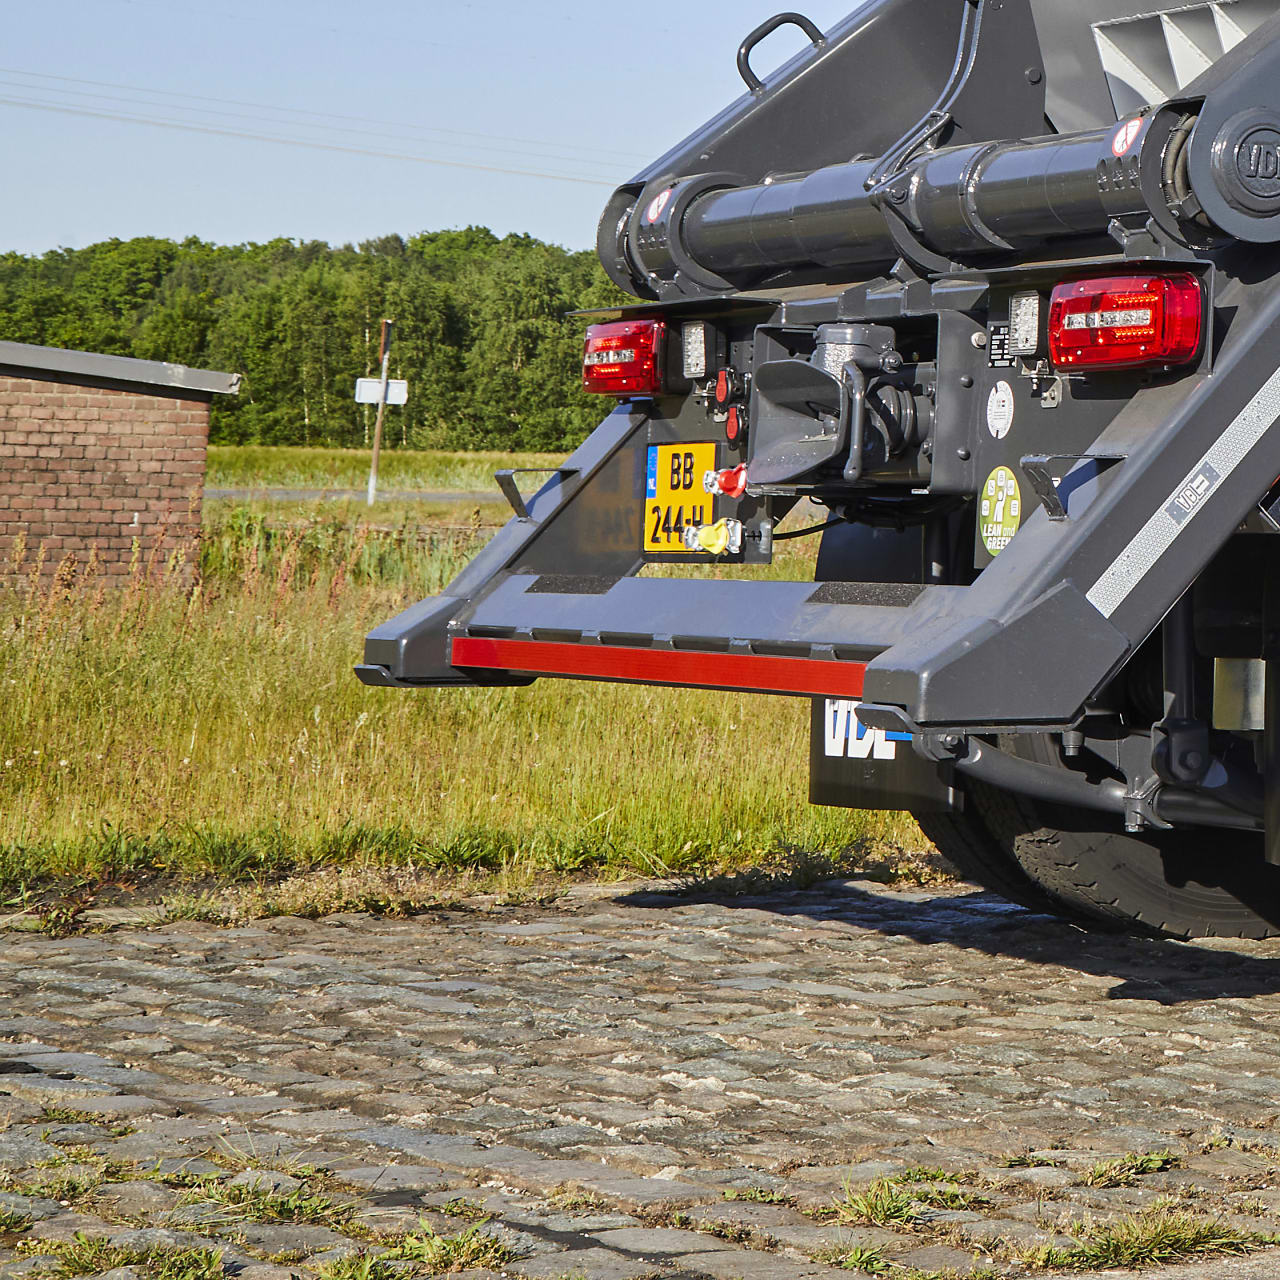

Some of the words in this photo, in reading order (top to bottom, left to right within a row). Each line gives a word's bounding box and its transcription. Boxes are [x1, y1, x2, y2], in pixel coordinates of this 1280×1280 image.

[670, 452, 694, 490] BB
[1174, 482, 1206, 513] VDL
[983, 523, 1002, 537] LEAN
[1003, 524, 1016, 537] and
[825, 698, 896, 760] VDL
